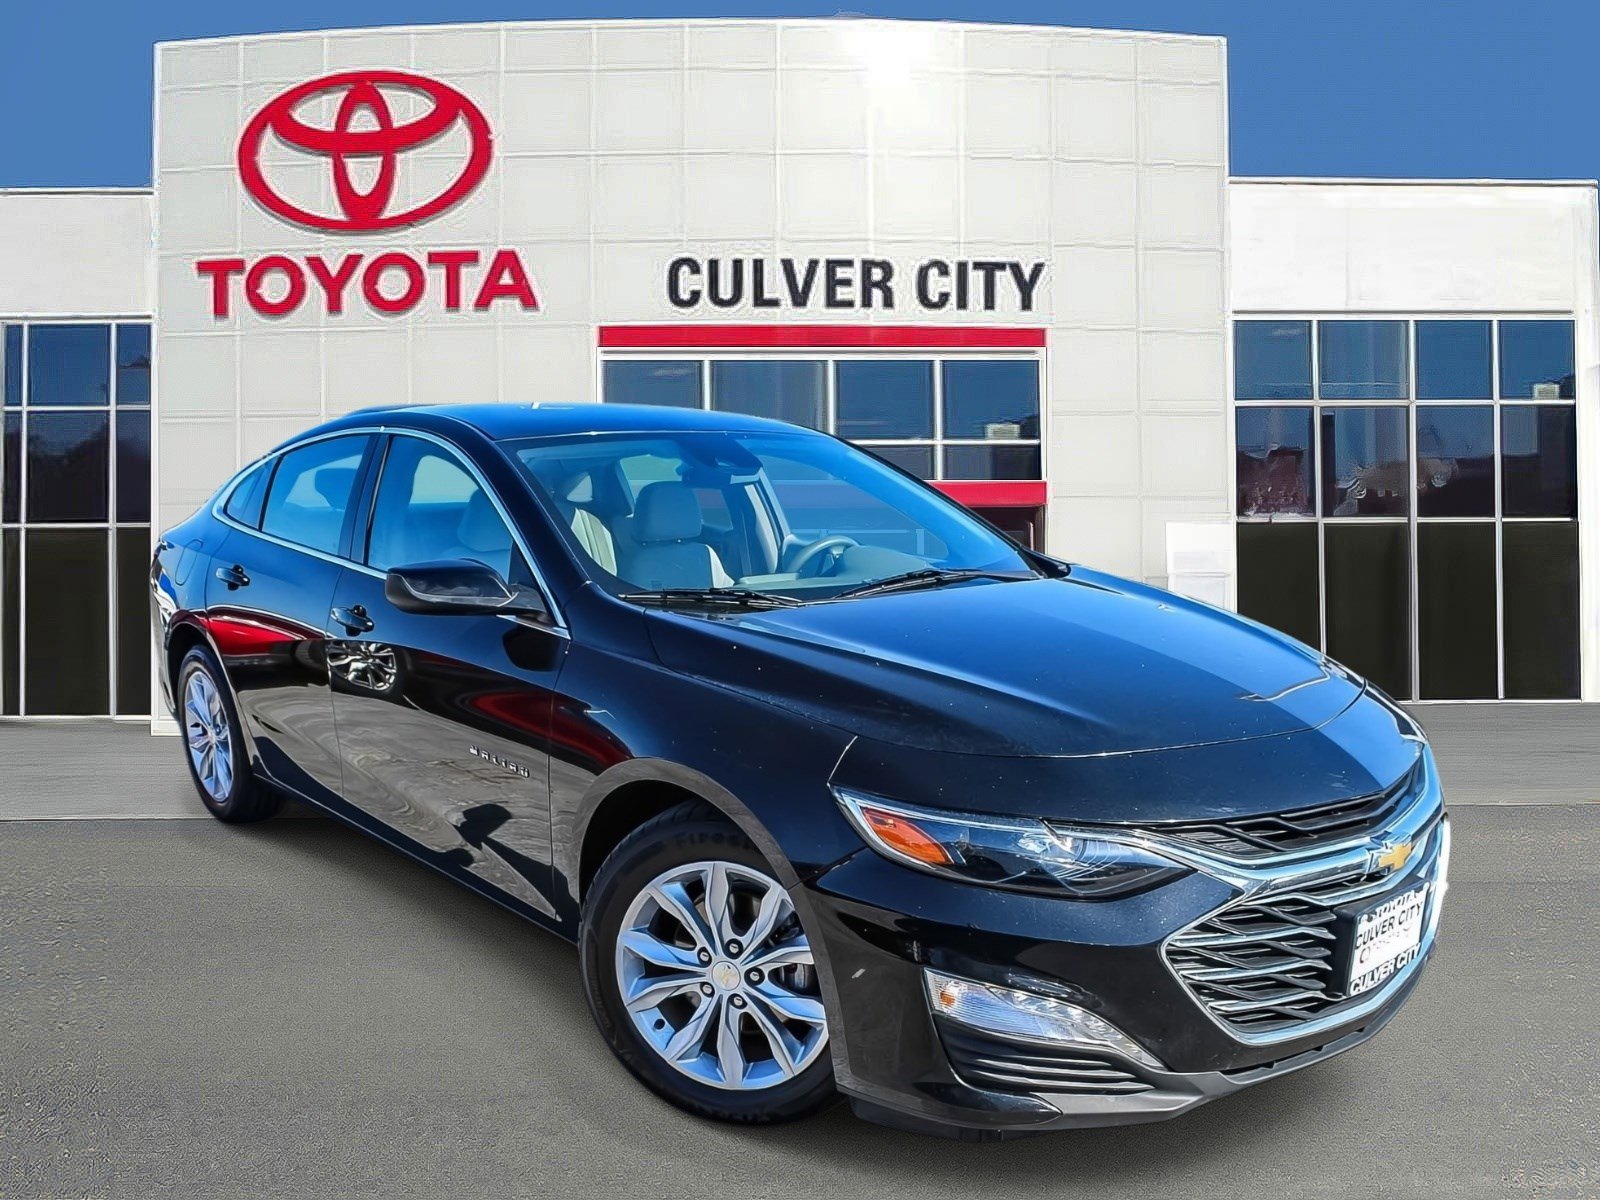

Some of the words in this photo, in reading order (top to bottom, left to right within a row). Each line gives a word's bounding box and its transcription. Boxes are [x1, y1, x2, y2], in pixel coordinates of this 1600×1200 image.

[196, 250, 538, 318] TOYOTA
[668, 257, 894, 309] CULVER
[916, 259, 1045, 311] CITY
[1355, 915, 1395, 950] CULVER
[1398, 901, 1423, 927] CITY
[1350, 958, 1395, 994] CULVER
[1396, 943, 1422, 969] CITY
